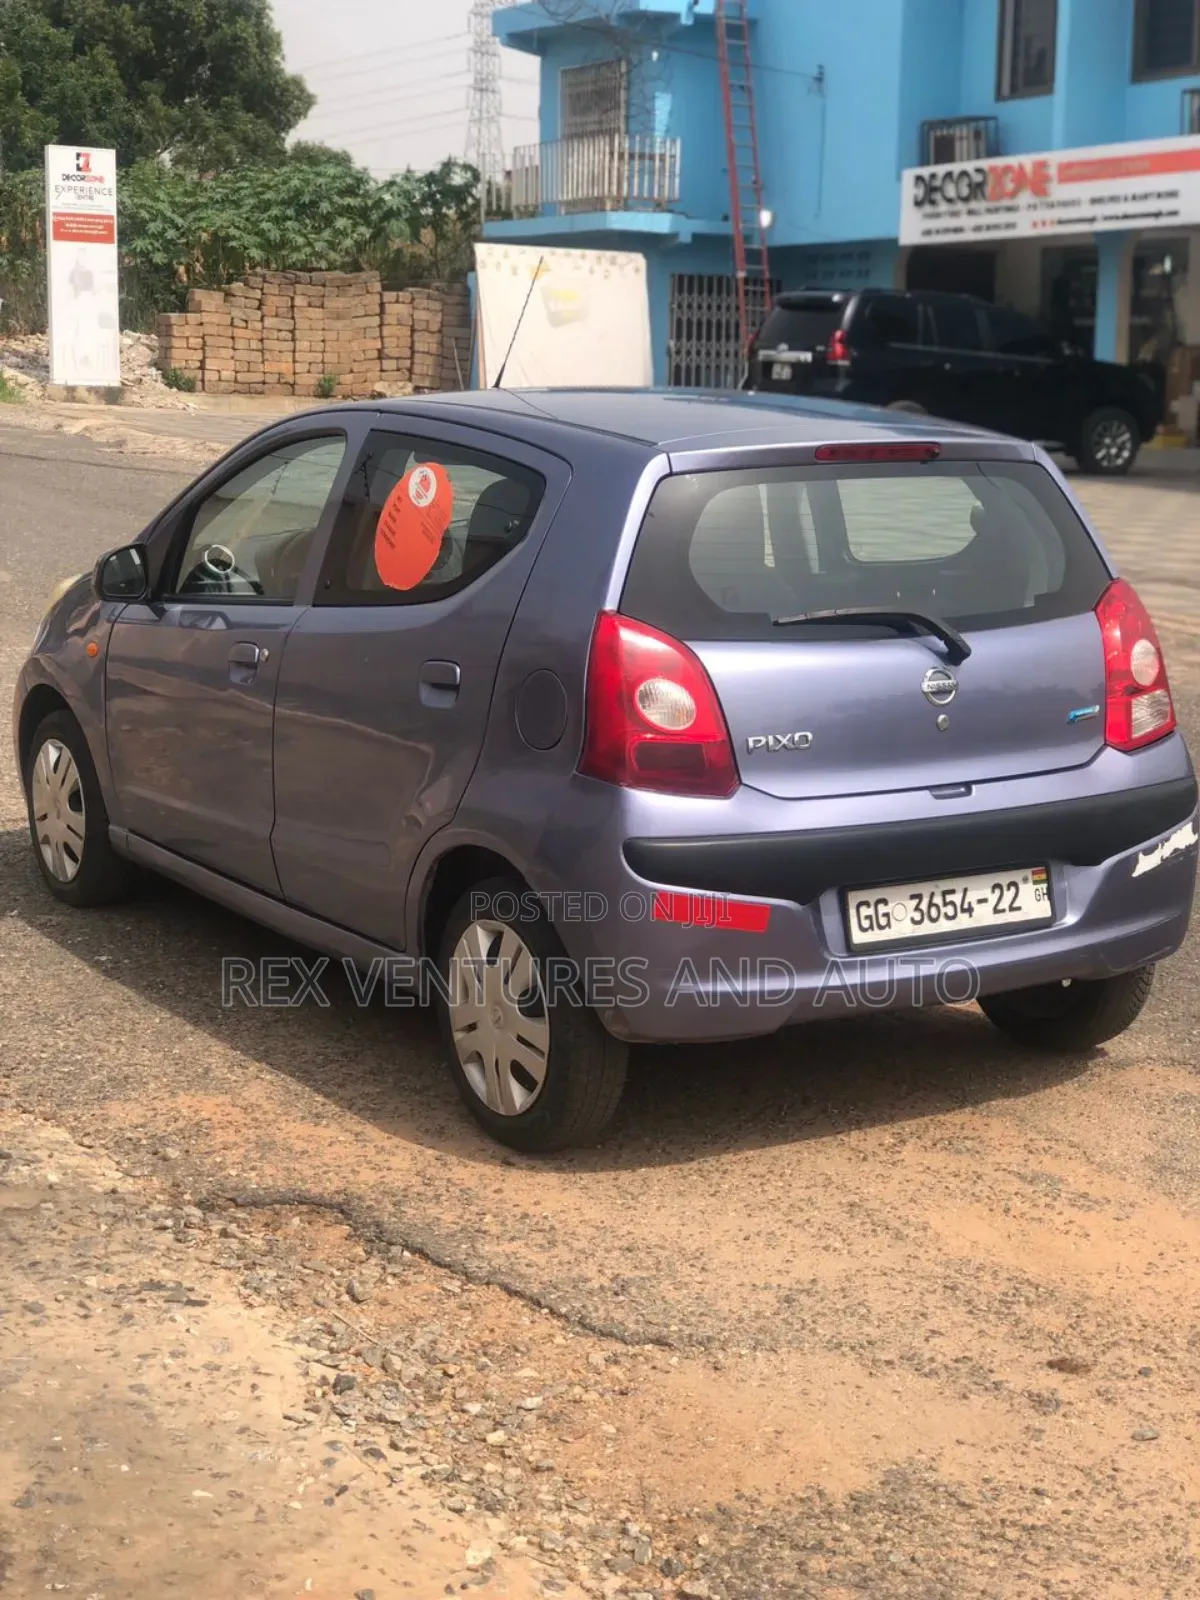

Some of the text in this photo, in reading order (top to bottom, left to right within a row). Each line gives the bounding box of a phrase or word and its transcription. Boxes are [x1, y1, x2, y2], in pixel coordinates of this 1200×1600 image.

[54, 185, 113, 198] EXPERIENCE
[747, 731, 813, 754] PIXO
[1034, 886, 1049, 902] GH
[855, 880, 1023, 932] GG 3654-22
